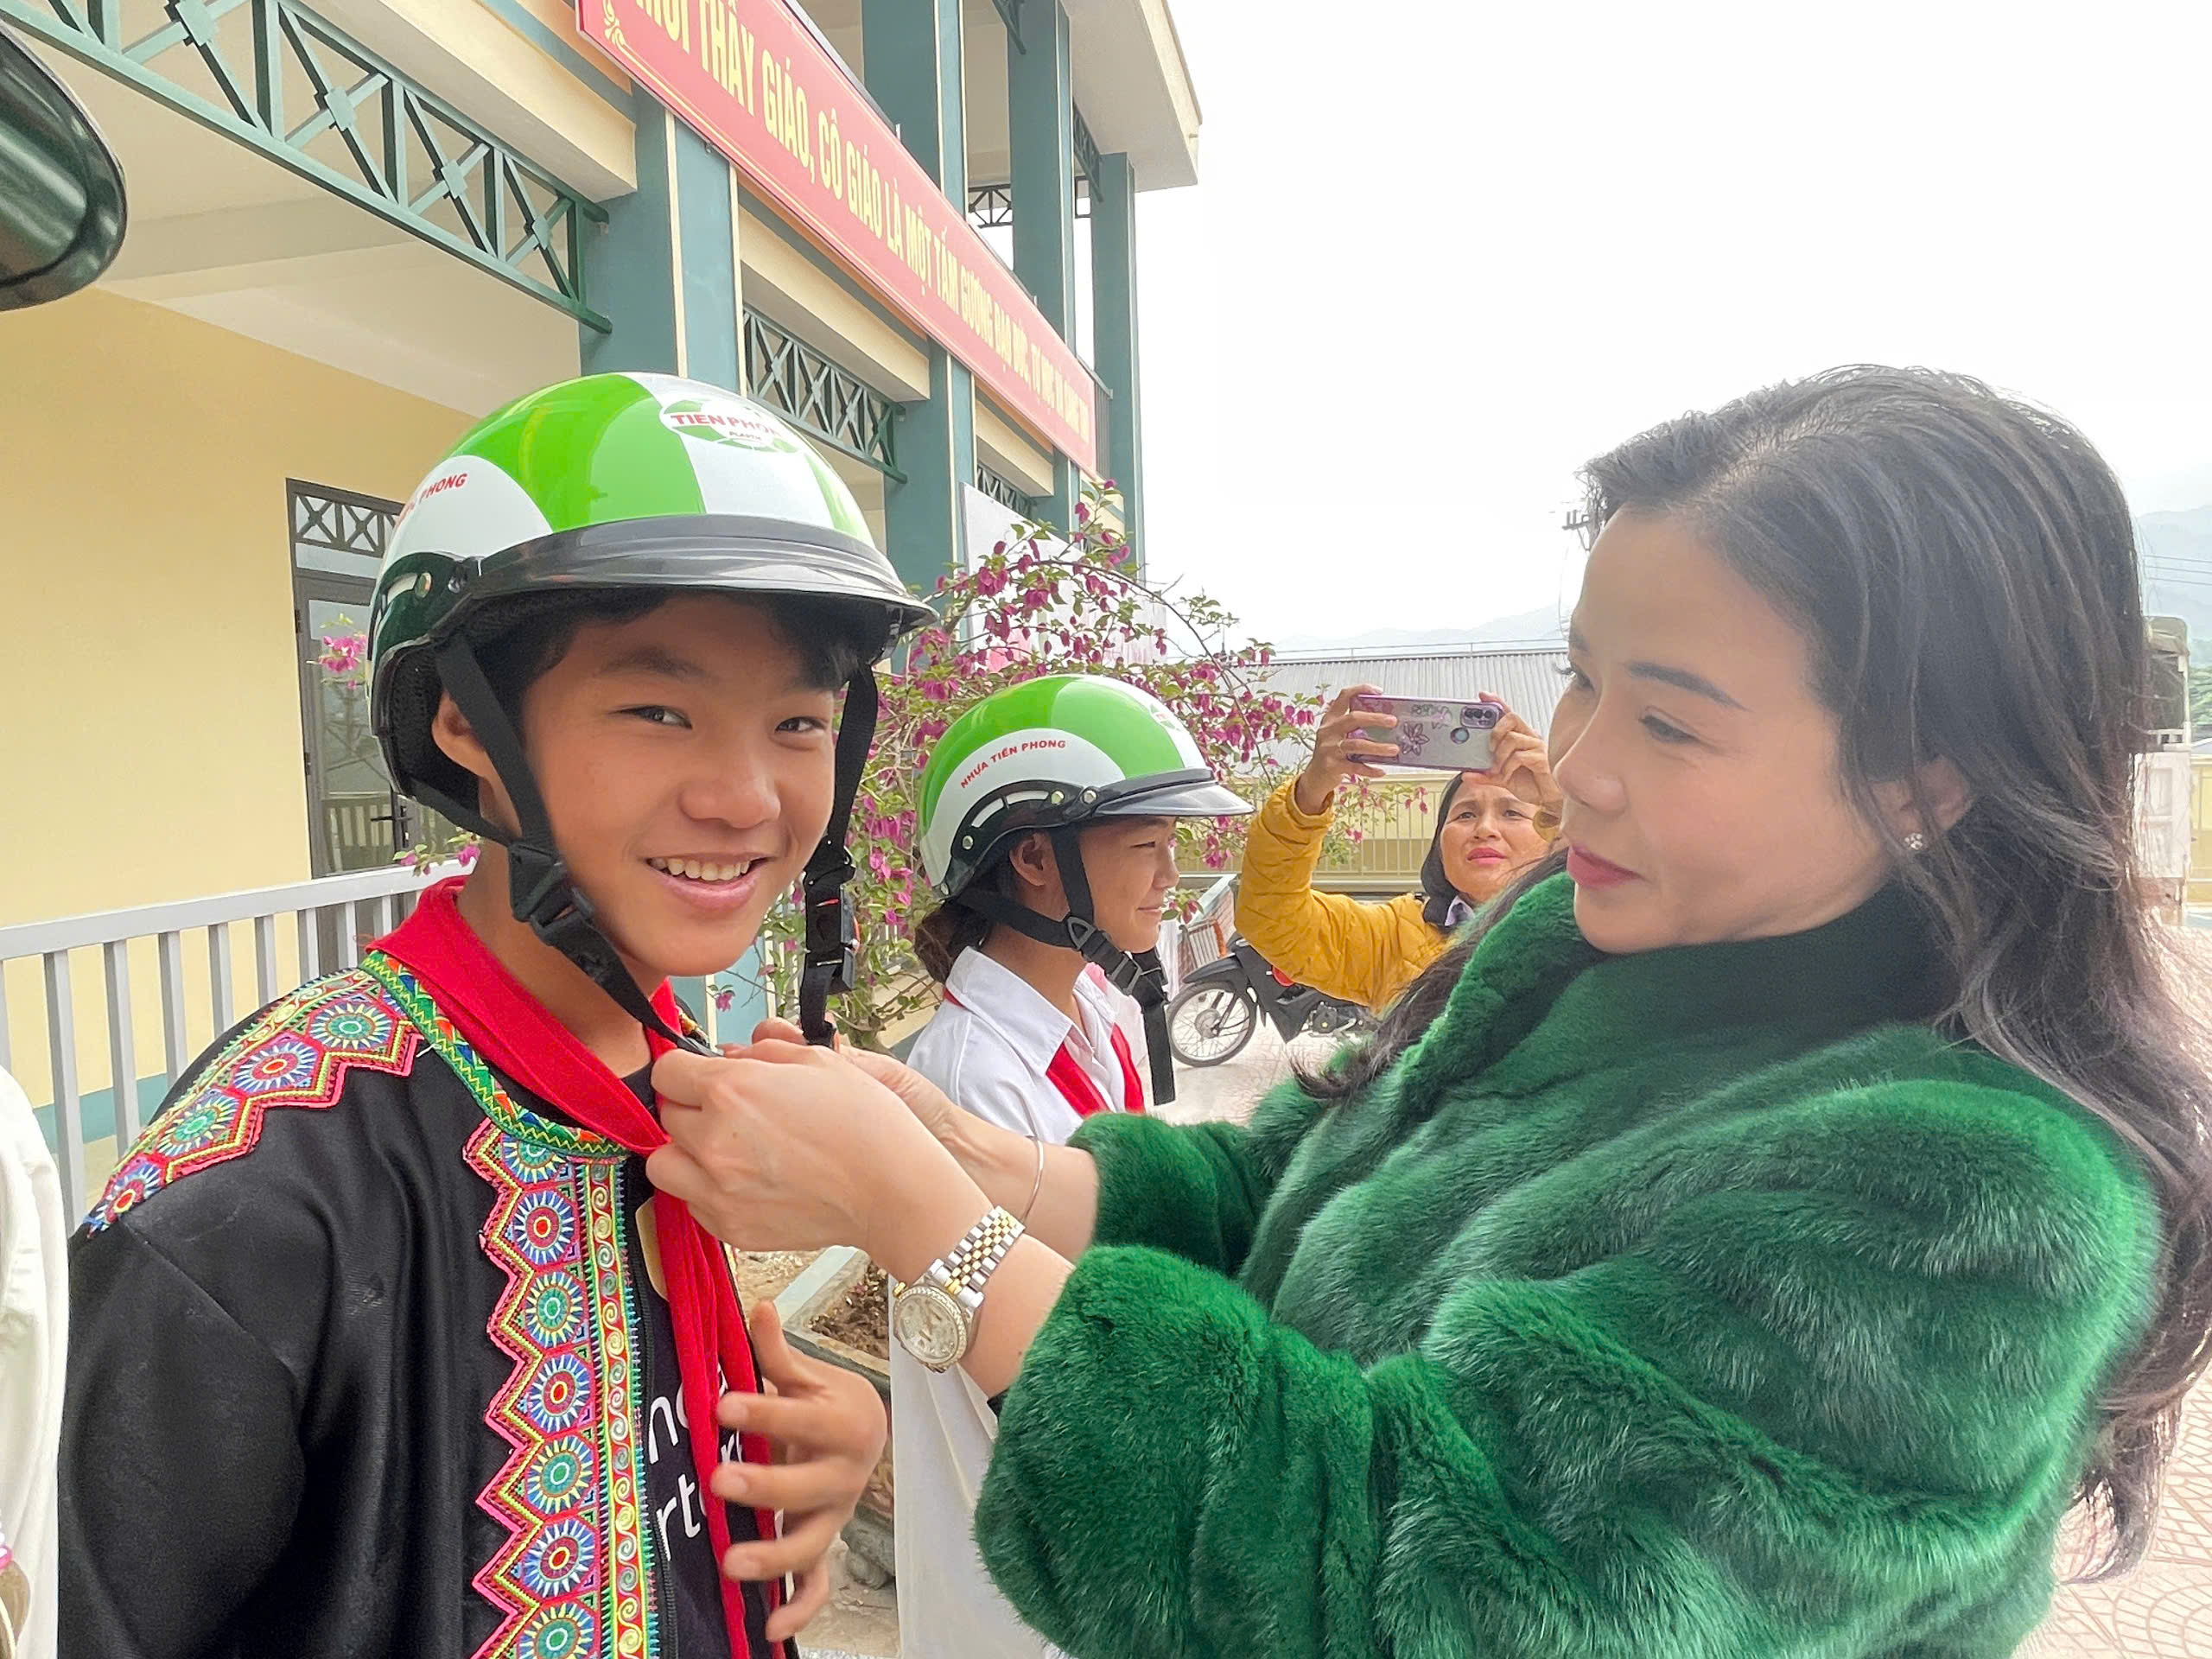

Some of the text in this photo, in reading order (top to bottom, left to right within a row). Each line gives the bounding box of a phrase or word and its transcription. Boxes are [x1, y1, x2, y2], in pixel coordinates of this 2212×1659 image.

[761, 49, 816, 184] GIÁO,
[817, 107, 842, 201] CÔ
[846, 140, 883, 239] GIÁO
[884, 176, 904, 262] LÀ
[905, 204, 932, 297] MỘT
[933, 226, 960, 315] TẤM
[1021, 740, 1066, 751] PHONG
